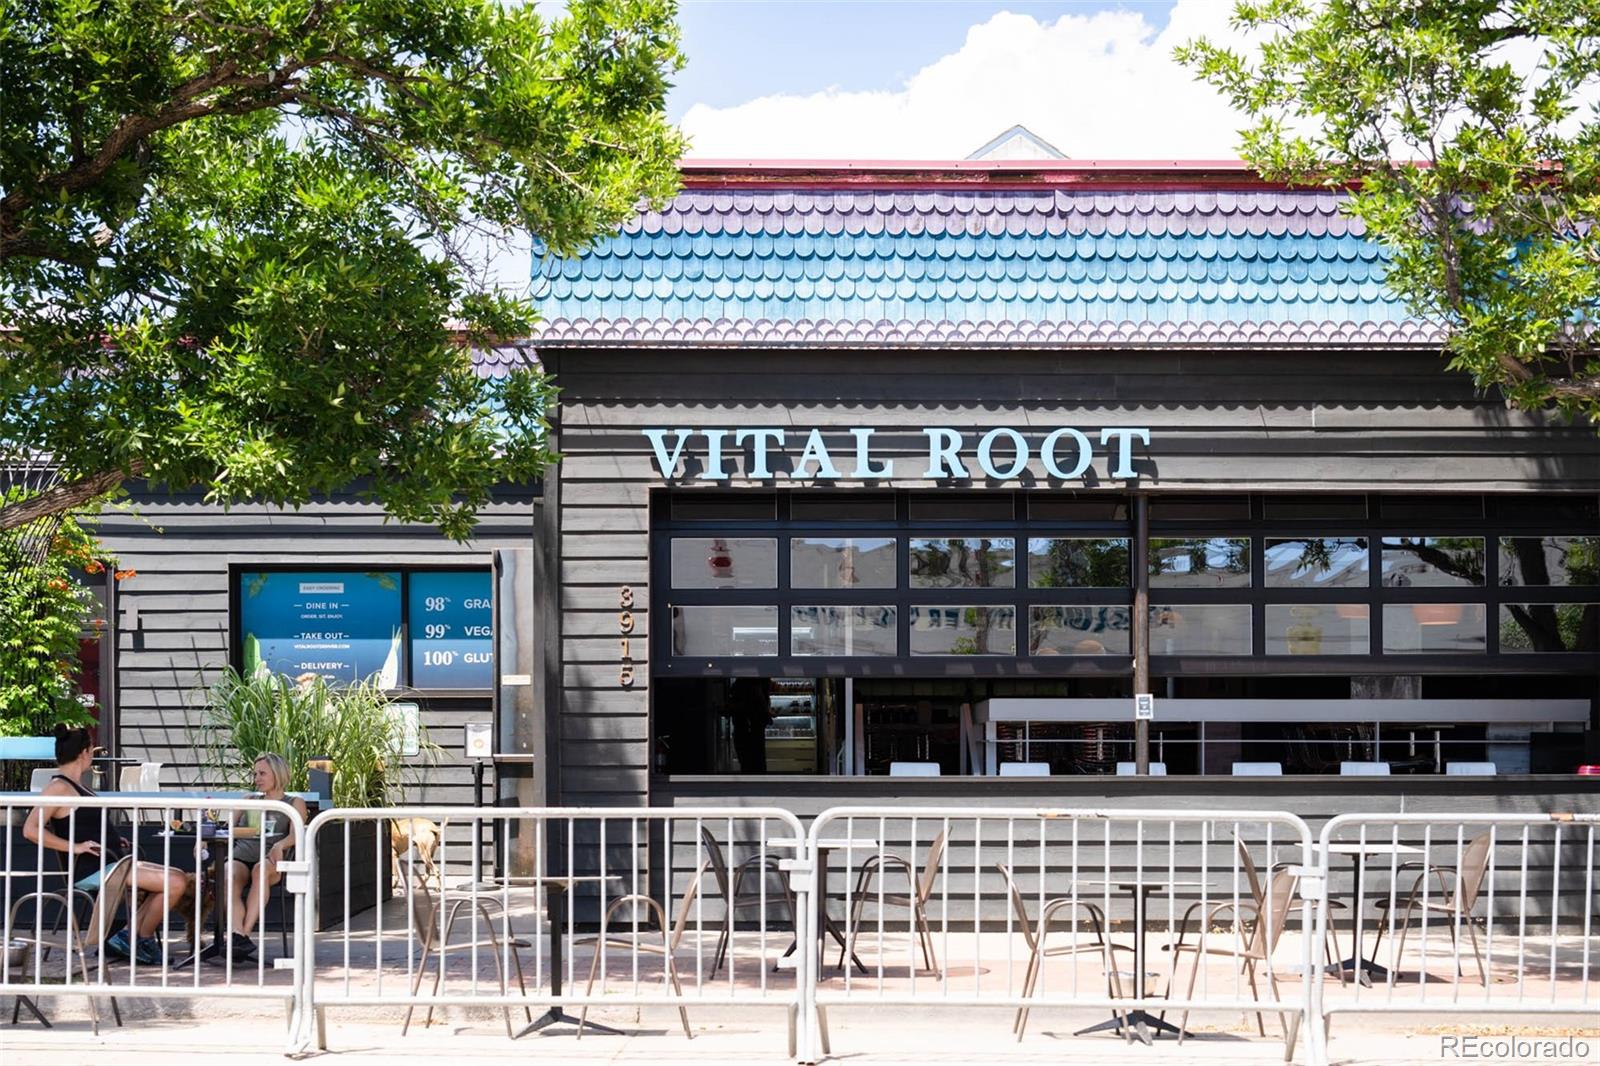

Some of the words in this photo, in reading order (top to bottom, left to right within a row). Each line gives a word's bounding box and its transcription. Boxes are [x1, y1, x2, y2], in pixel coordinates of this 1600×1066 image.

[642, 428, 894, 480] VITAL
[923, 428, 1151, 480] ROOT
[306, 602, 327, 610] DINE
[329, 602, 339, 610] IN
[301, 632, 322, 640] TAKE
[324, 632, 343, 640] OUT
[464, 626, 493, 637] VEG
[620, 585, 634, 687] 3915
[301, 662, 342, 670] DELIVERY
